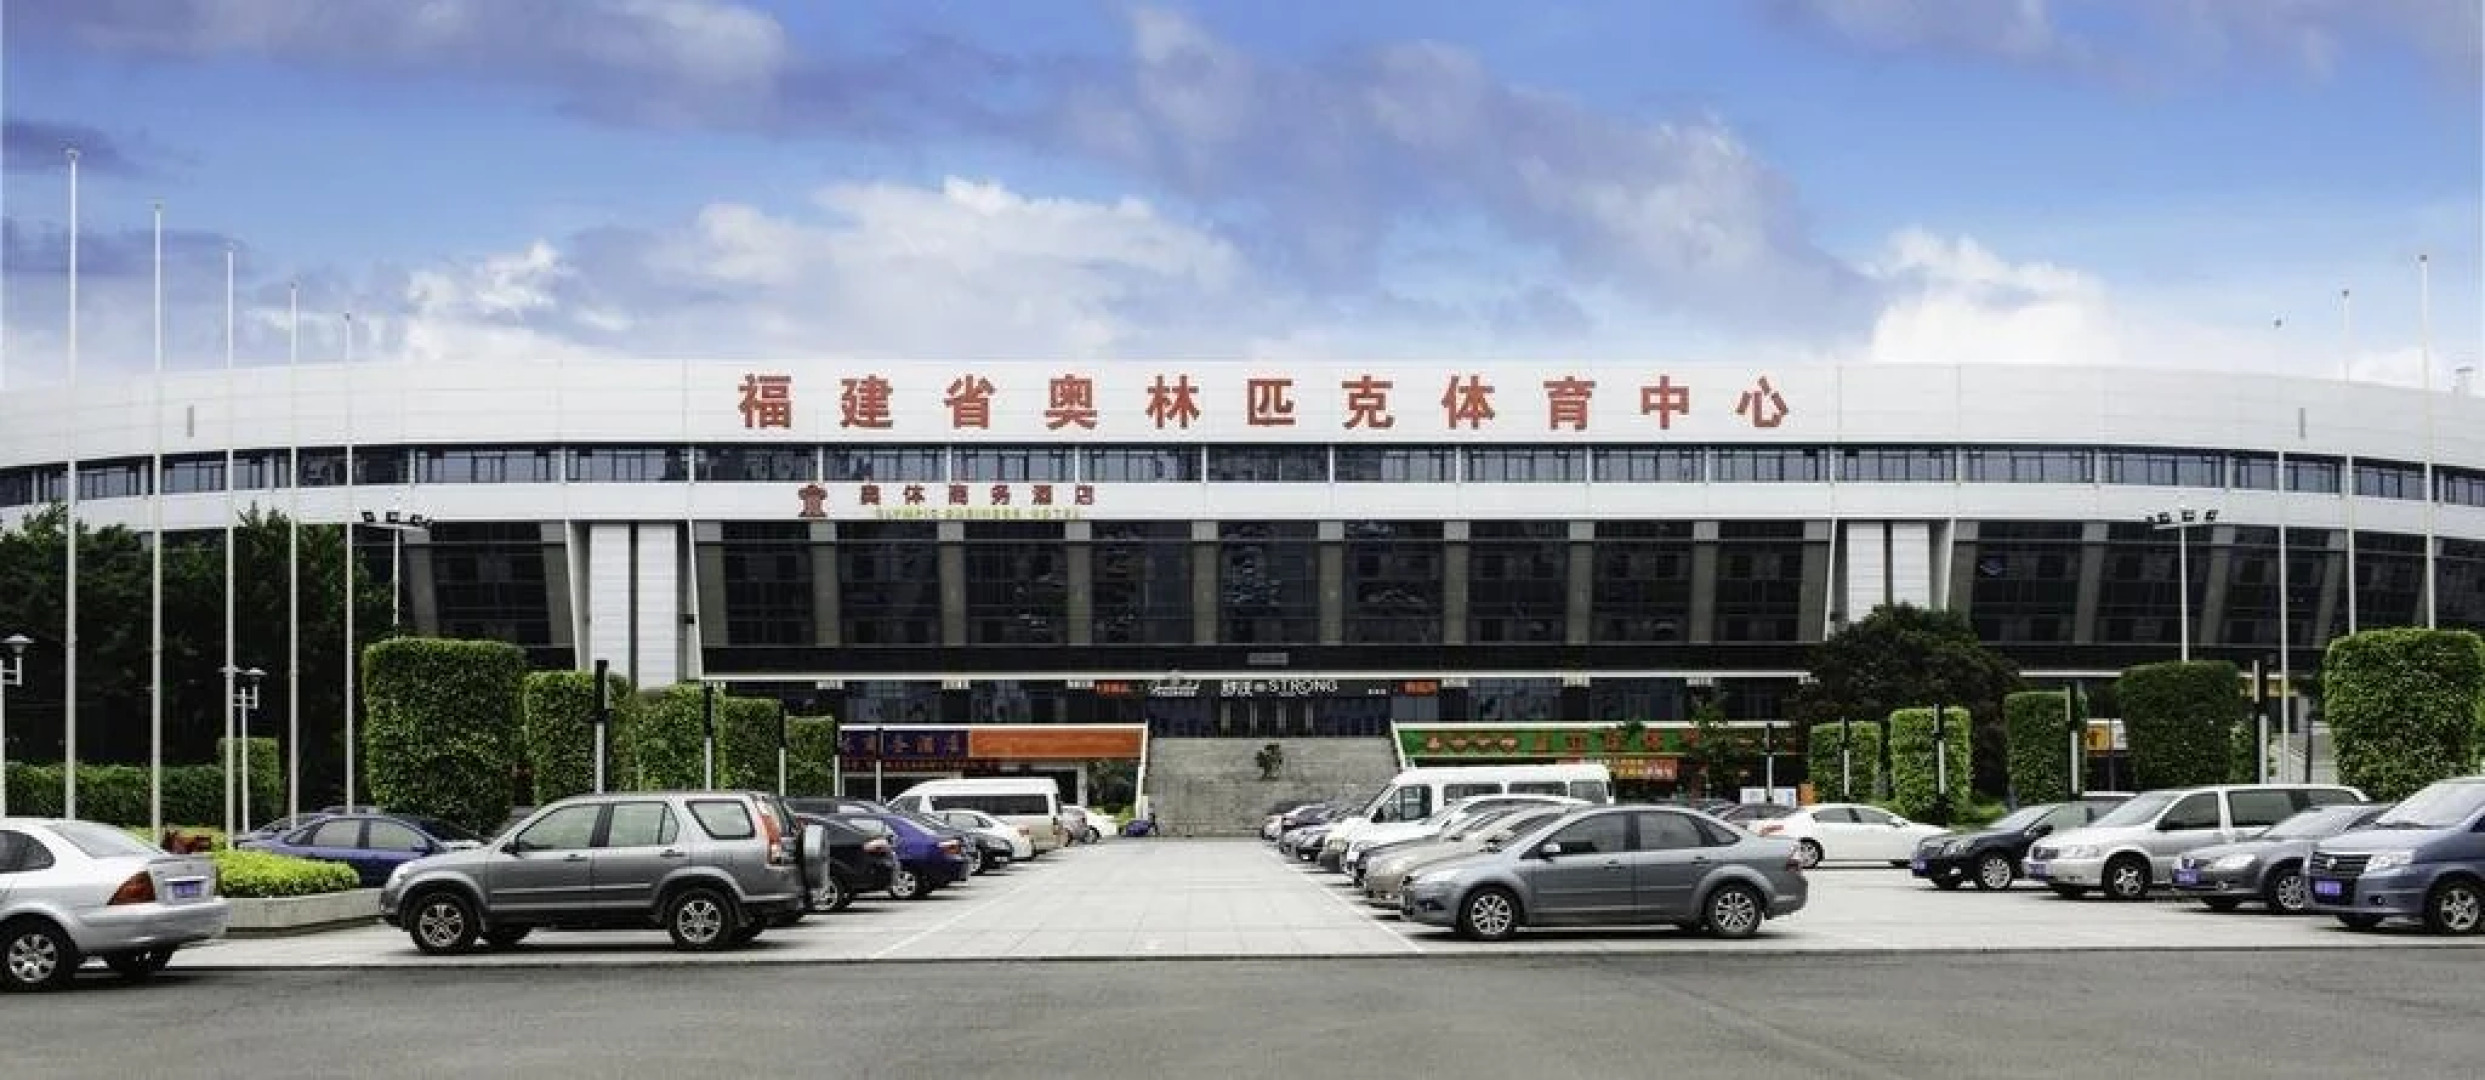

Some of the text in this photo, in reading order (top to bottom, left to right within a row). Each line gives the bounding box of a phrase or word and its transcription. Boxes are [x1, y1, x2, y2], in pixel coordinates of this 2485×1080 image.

[738, 374, 1789, 430] 福建省奥林匹克体育中心
[859, 484, 1095, 506] 奥体商务酒店
